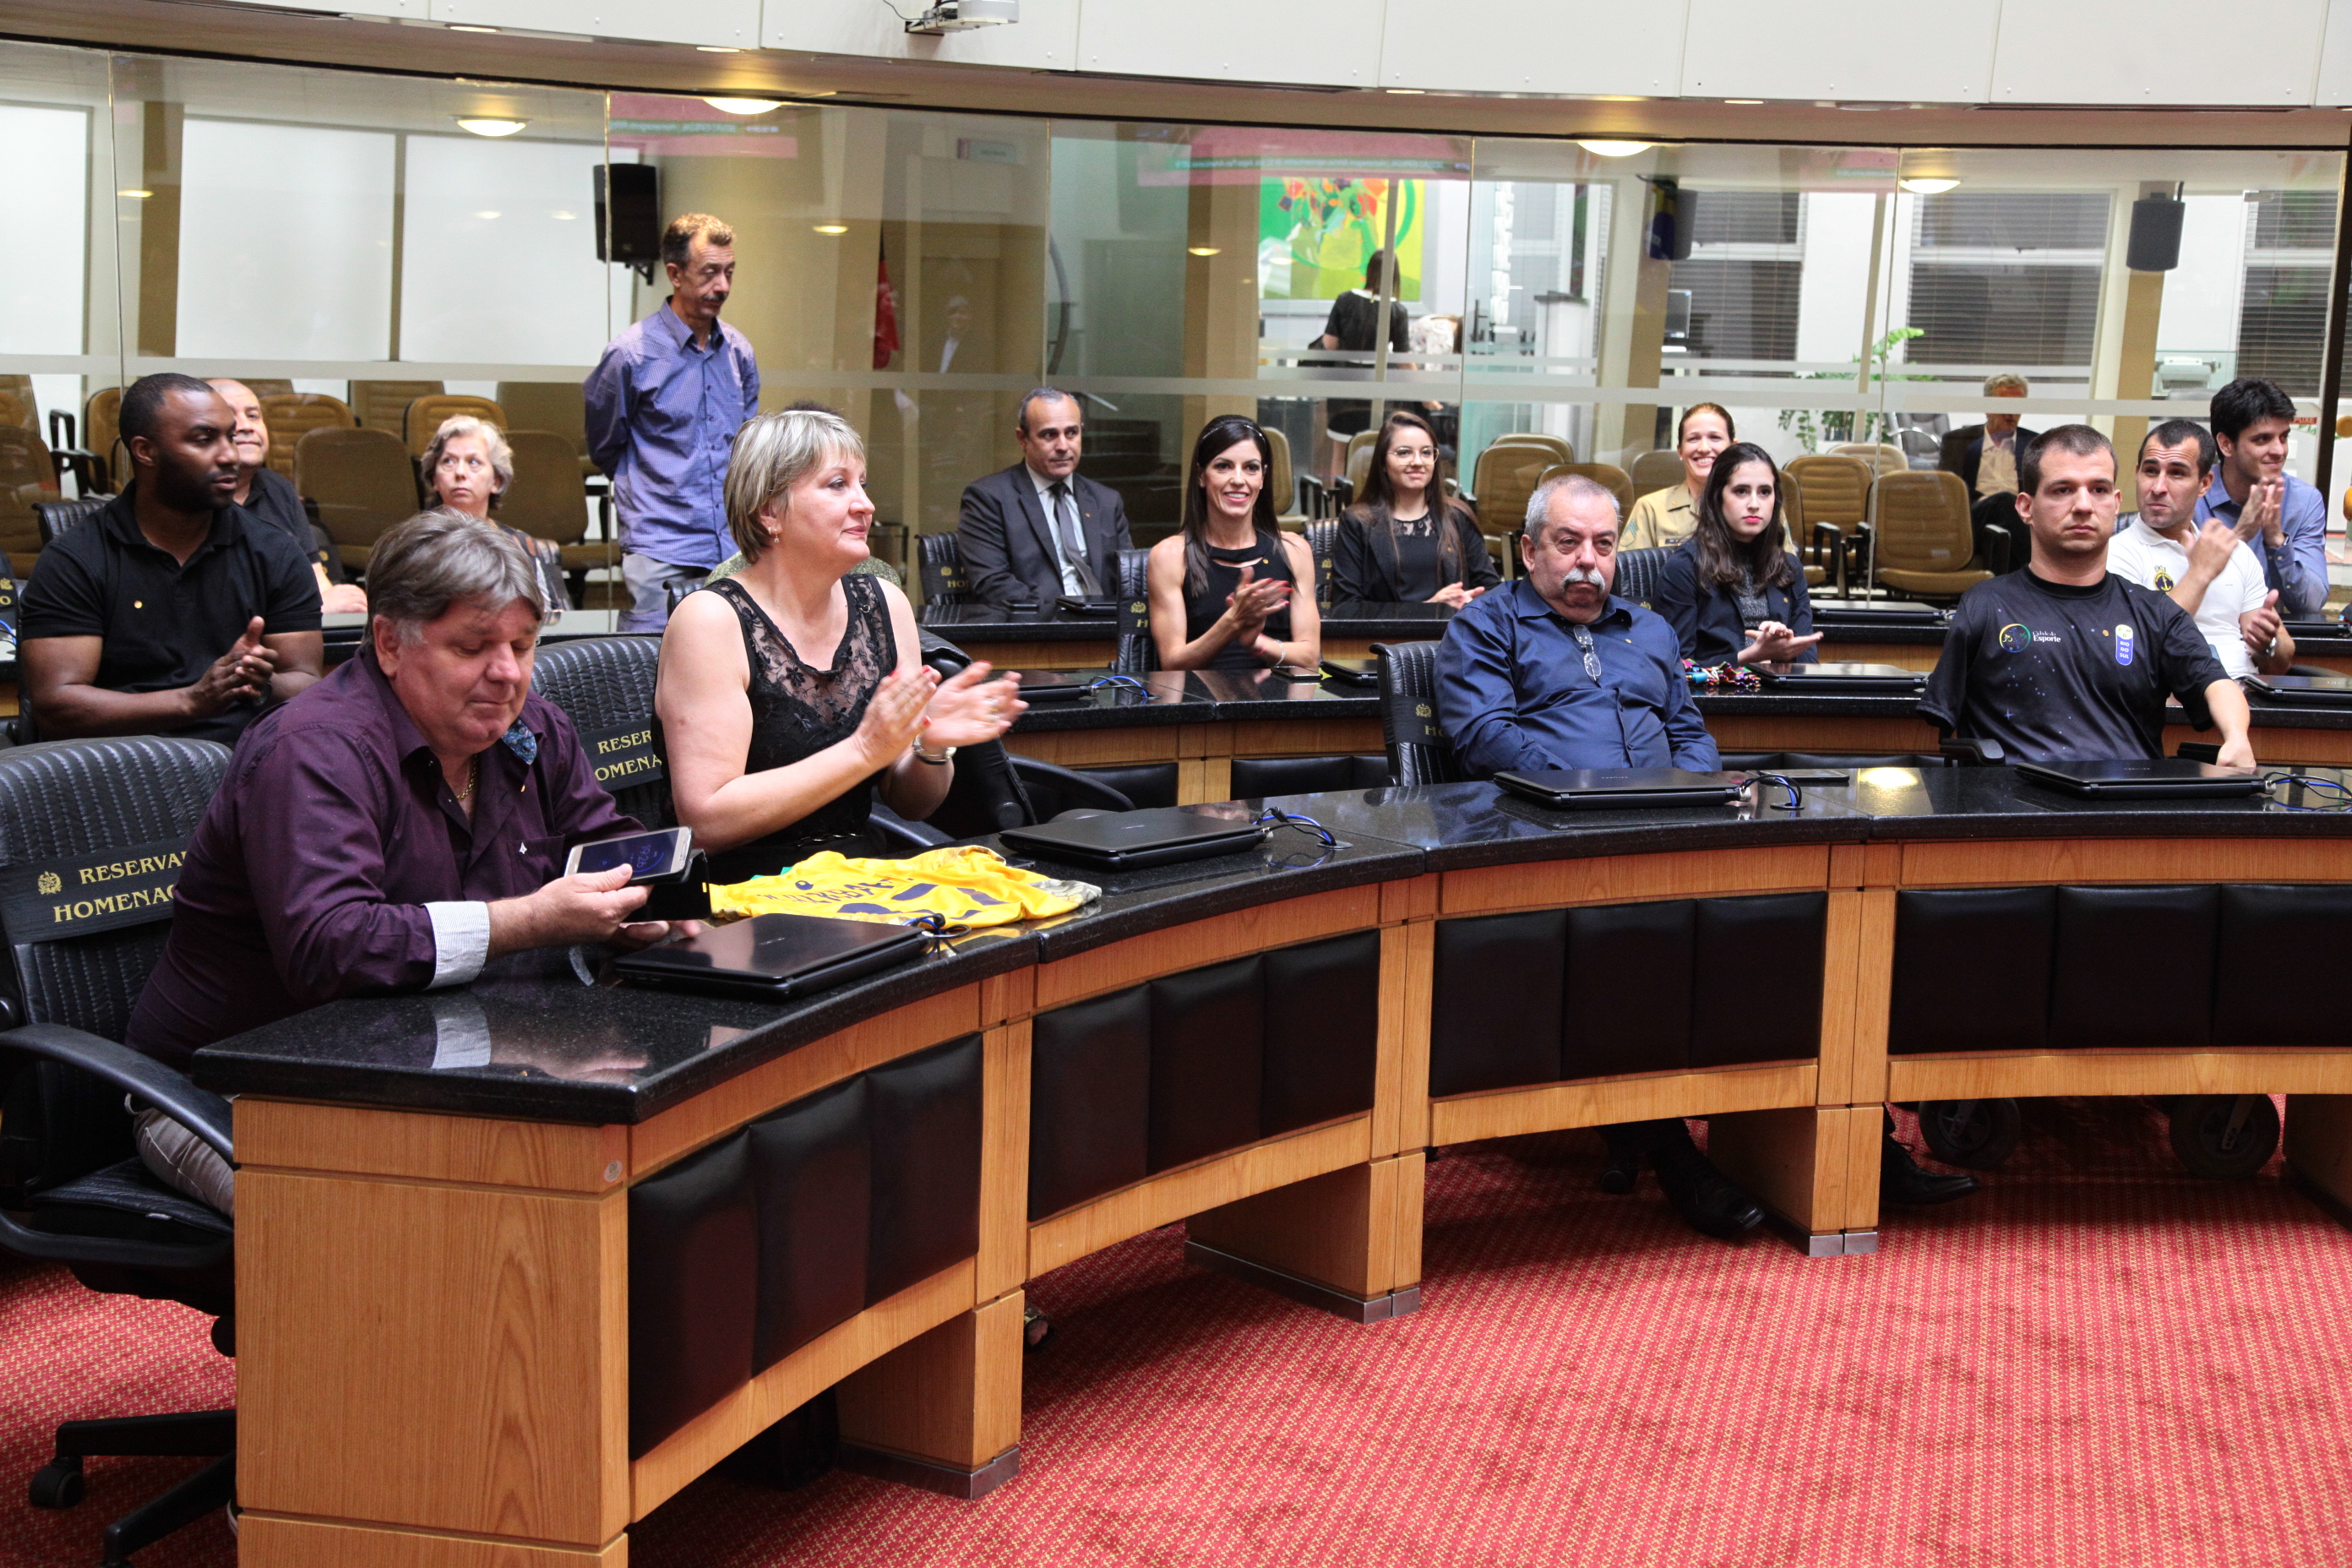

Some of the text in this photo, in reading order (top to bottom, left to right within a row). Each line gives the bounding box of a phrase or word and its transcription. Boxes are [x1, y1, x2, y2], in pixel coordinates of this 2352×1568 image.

[2033, 634, 2061, 643] Esporte
[597, 730, 652, 754] RESER
[79, 851, 188, 885] RESERVA
